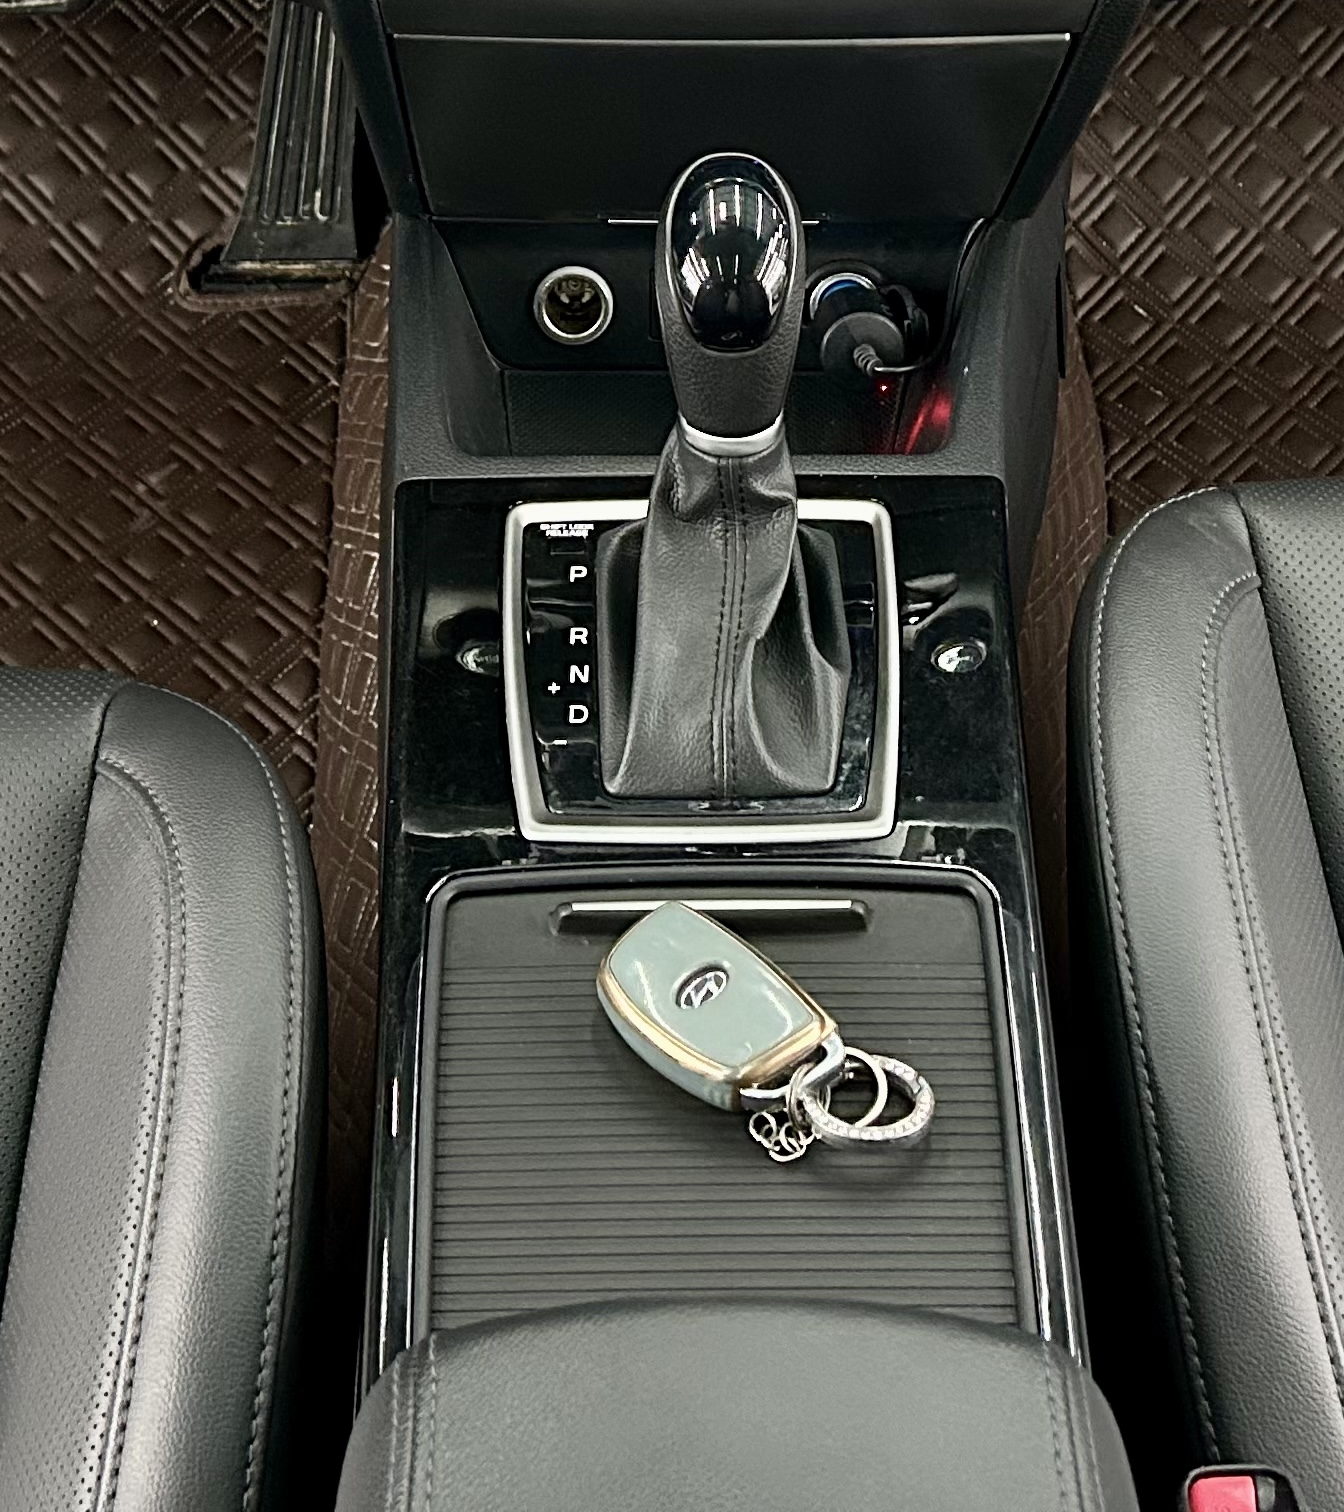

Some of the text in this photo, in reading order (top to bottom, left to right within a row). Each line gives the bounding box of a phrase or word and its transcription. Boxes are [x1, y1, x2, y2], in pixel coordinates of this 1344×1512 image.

[569, 565, 588, 583] P
[569, 627, 589, 646] R
[569, 664, 590, 684] N
[568, 704, 589, 724] D
